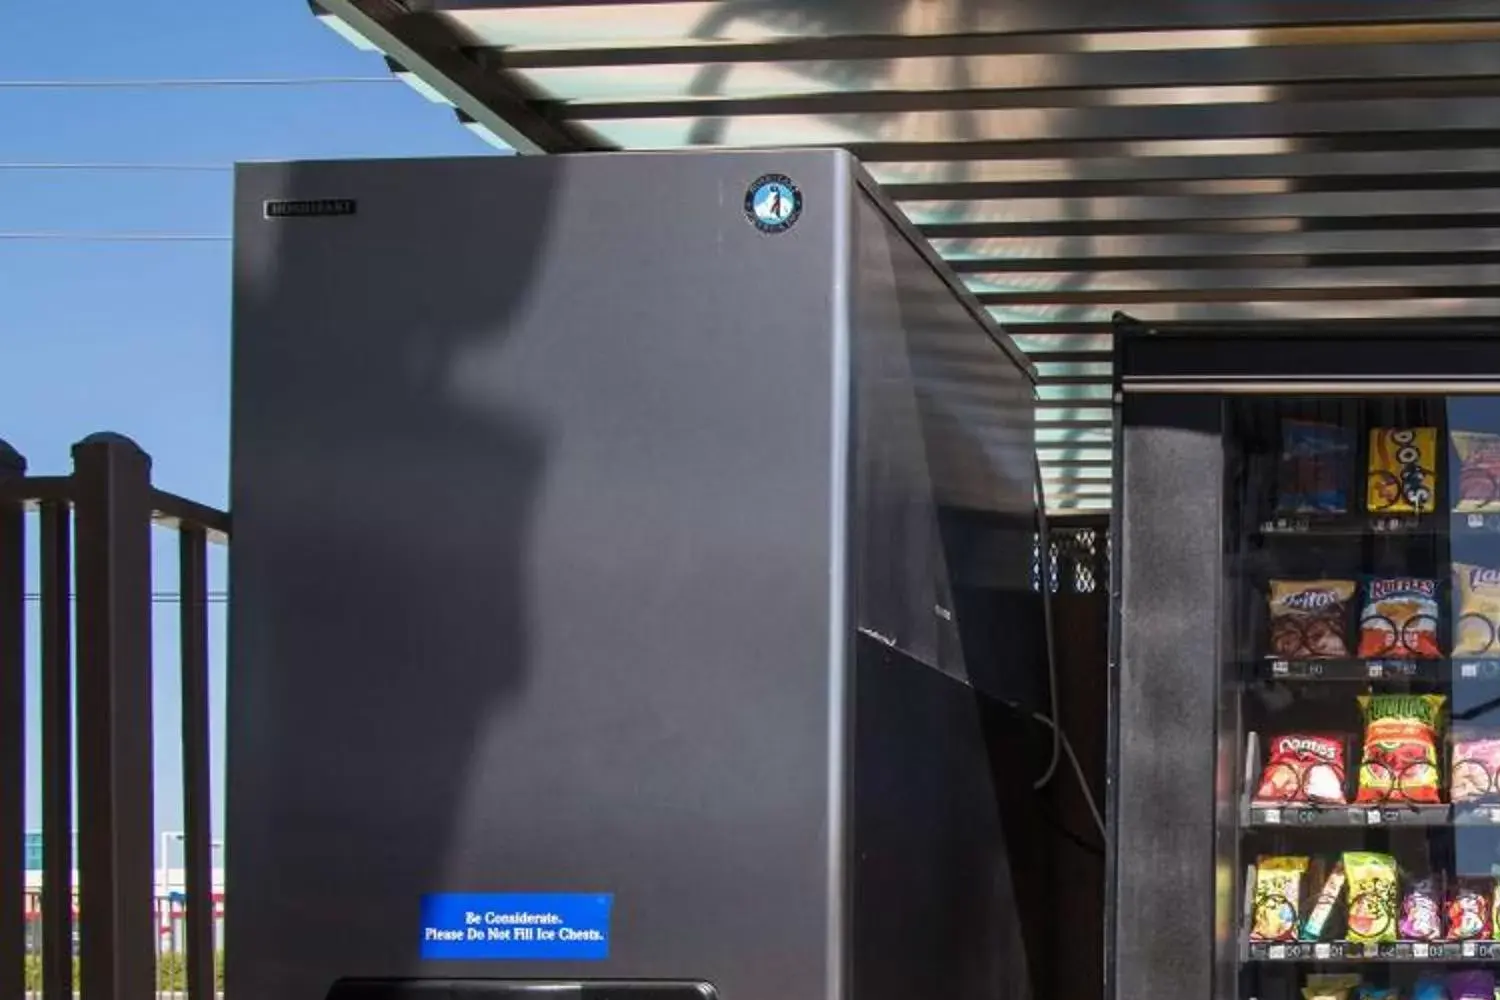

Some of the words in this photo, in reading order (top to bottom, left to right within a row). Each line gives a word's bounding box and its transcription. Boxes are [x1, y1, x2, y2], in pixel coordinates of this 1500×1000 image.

[465, 911, 482, 925] Be
[485, 911, 564, 925] Considerate.
[425, 927, 464, 941] Please
[467, 927, 485, 941] Do
[487, 927, 511, 941] Not
[513, 927, 533, 941] Fill
[537, 927, 555, 941] Ice
[559, 927, 604, 942] Chests.
